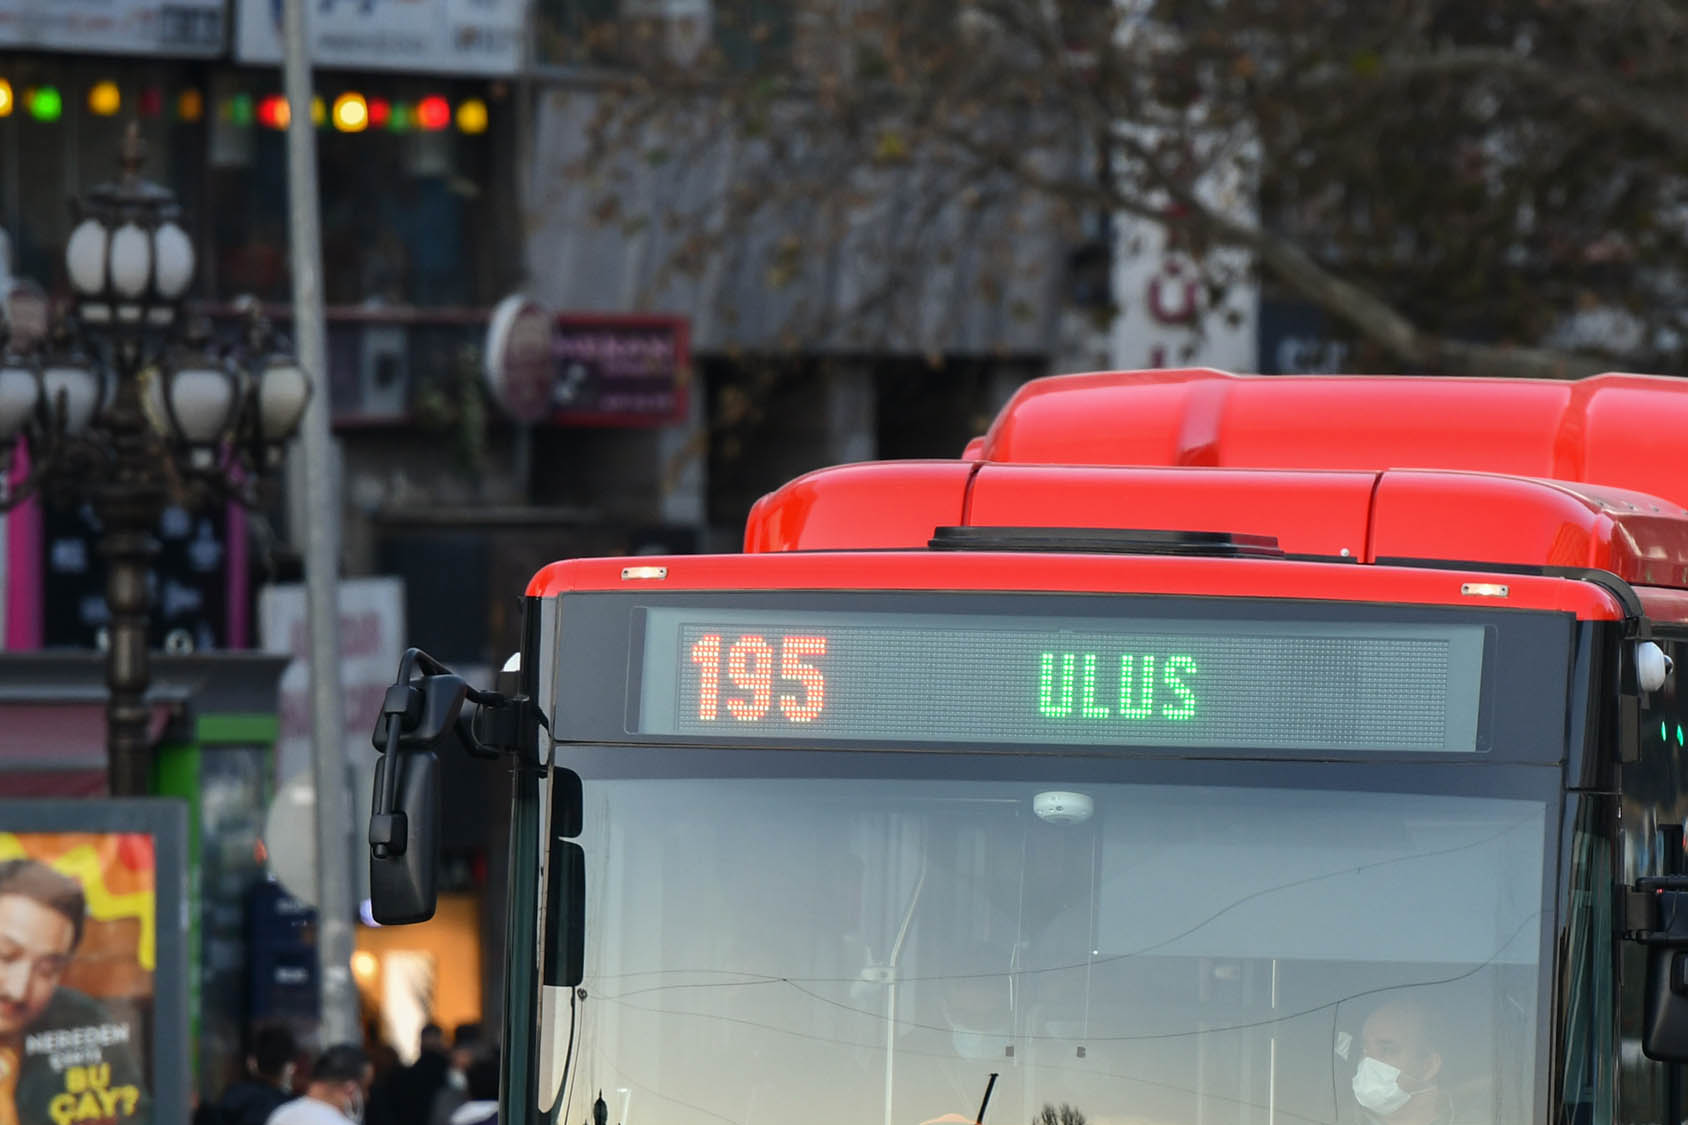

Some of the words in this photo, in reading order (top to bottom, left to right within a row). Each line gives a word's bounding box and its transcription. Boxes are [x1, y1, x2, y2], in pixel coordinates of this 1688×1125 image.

[692, 634, 827, 721] 195
[1040, 653, 1197, 720] ULUS
[66, 1062, 111, 1094] BU
